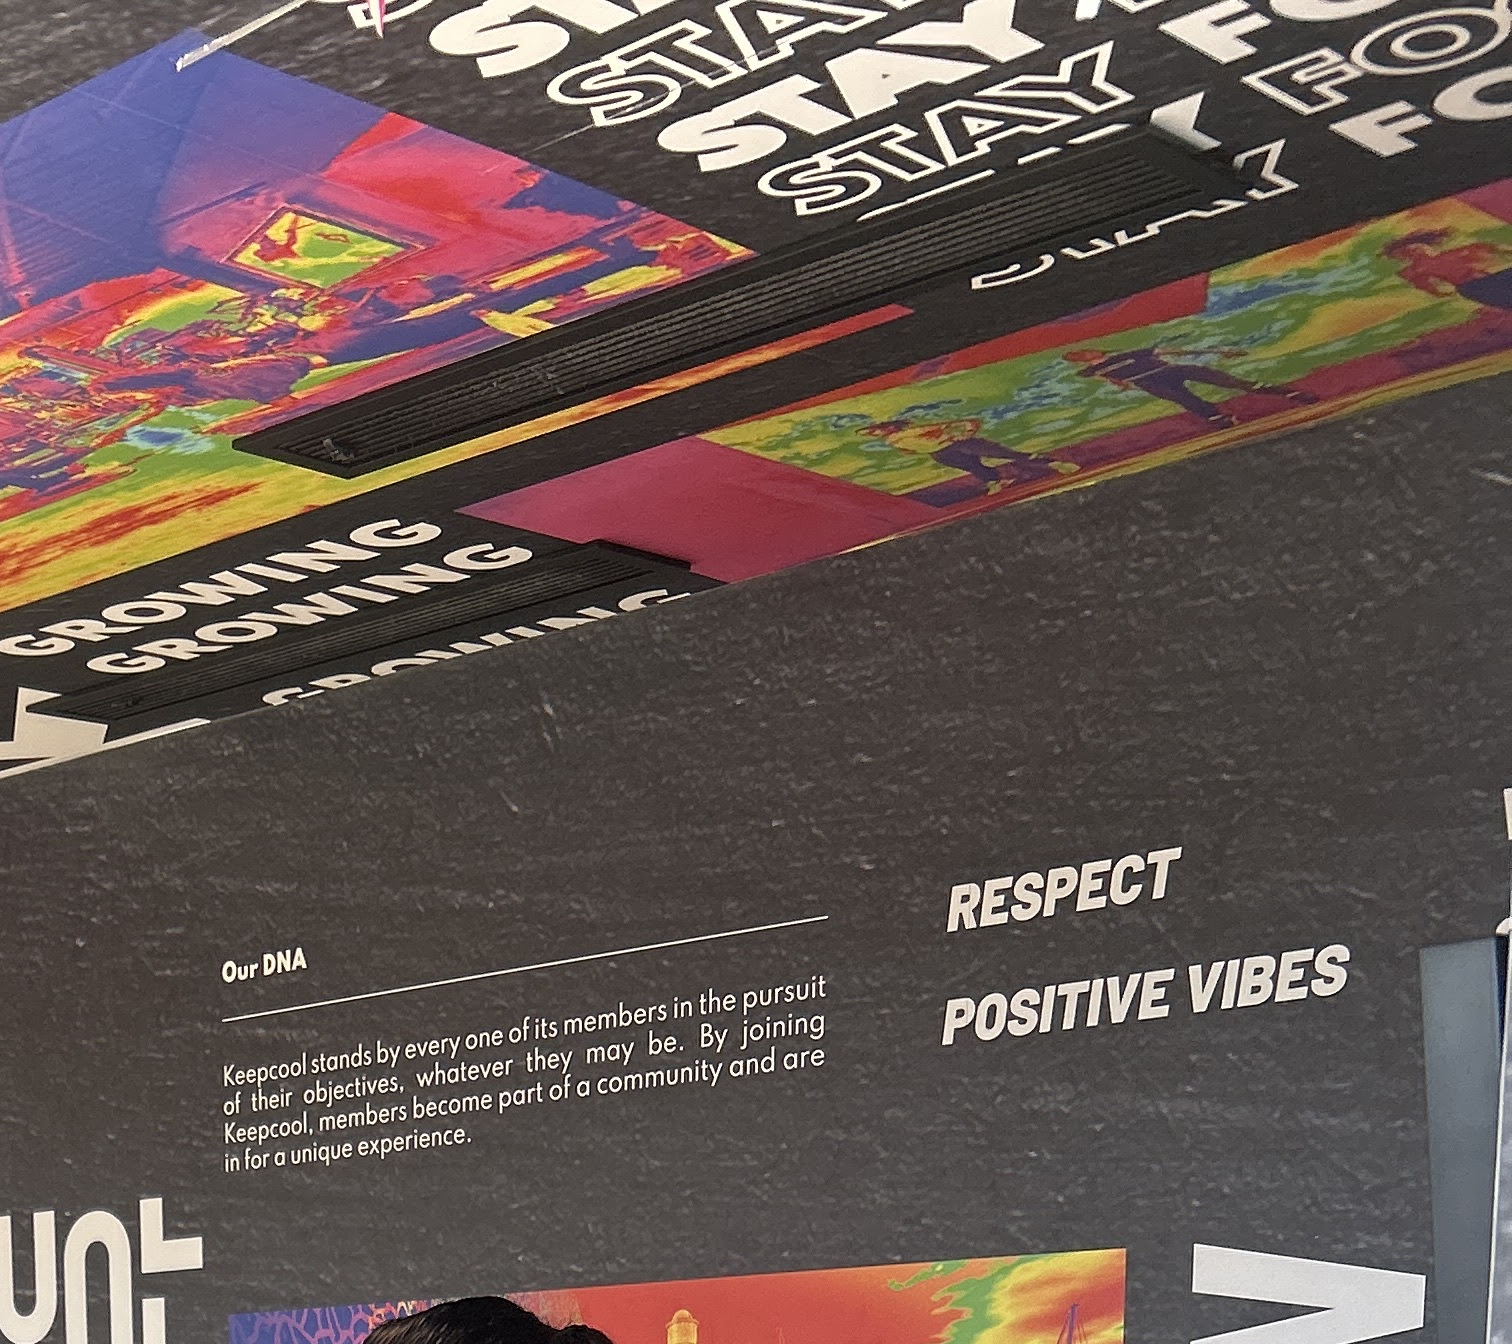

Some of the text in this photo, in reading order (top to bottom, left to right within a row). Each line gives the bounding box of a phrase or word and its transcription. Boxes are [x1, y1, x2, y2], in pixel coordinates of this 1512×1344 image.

[657, 0, 1045, 172] STAY
[757, 40, 1136, 216] STAY
[87, 543, 534, 675] GROWING
[946, 846, 1183, 933] RESPECT
[221, 947, 307, 984] Our DNA
[941, 943, 1351, 1046] POSITIVE VIBES
[223, 975, 826, 1089] Keepcool stands by every one of its members in the pursuit
[223, 1013, 825, 1116] of their objectives, whatever they may be. By joining
[224, 1046, 825, 1147] Keepcool, members become part of a community and are
[224, 1126, 472, 1173] in for a unique experience.
